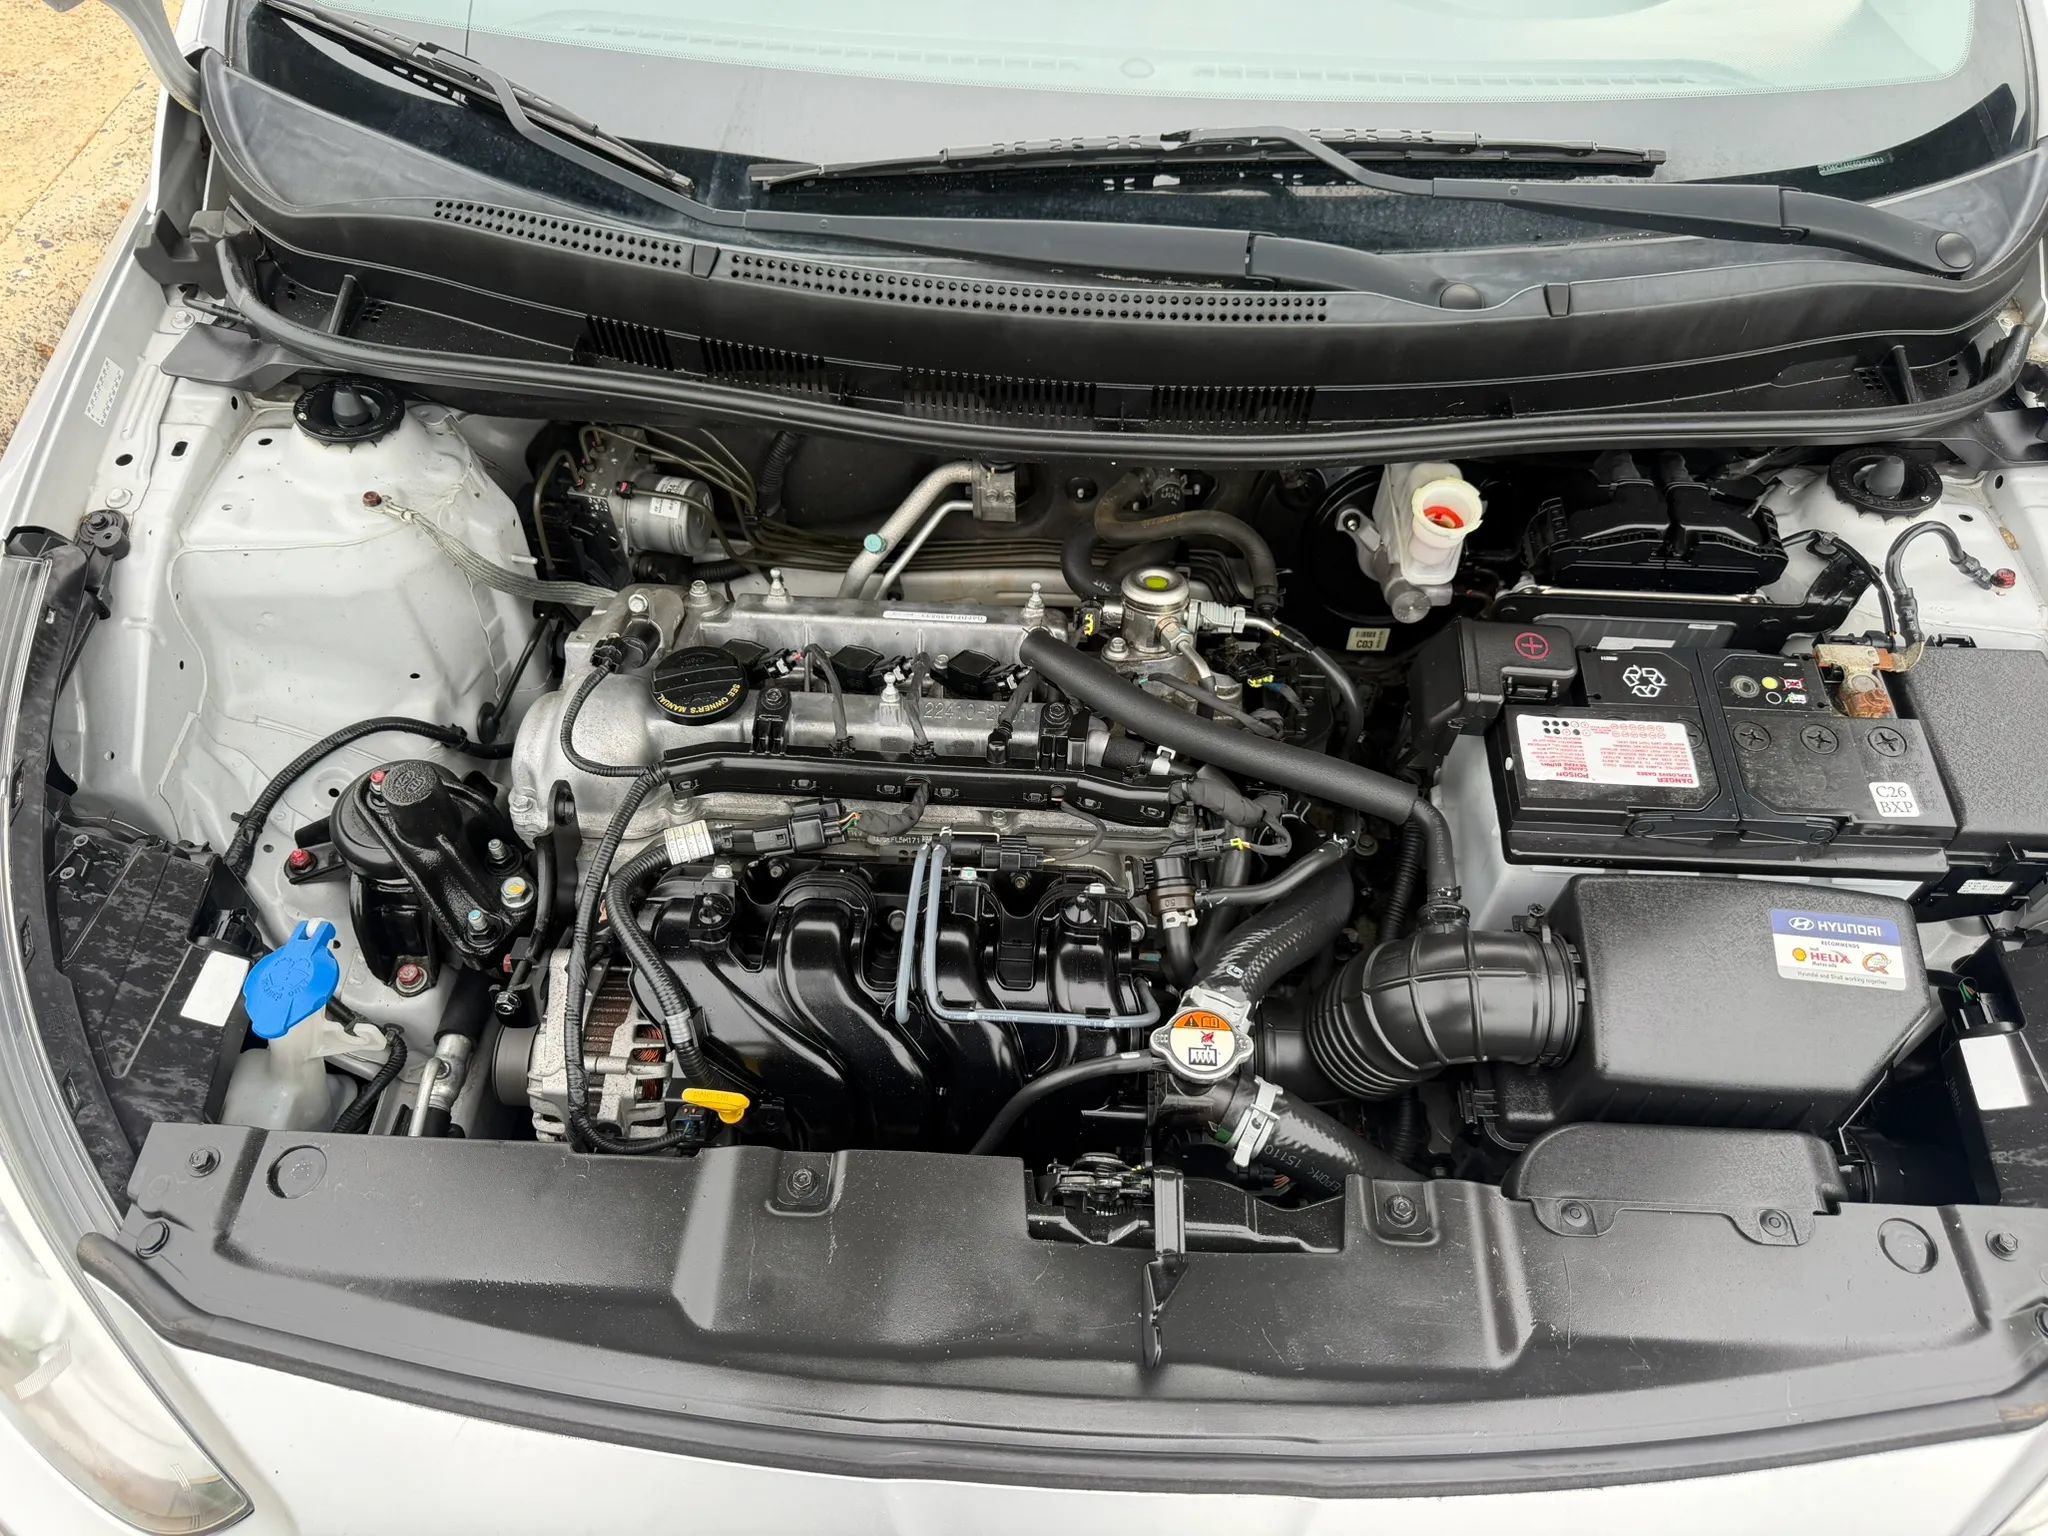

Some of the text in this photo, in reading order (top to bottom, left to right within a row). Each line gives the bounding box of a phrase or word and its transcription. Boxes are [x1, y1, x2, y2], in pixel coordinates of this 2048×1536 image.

[656, 683, 741, 714] SEE OWNER'S MANUAL
[1555, 771, 1589, 779] POISON
[1876, 786, 1907, 798] C26
[1880, 801, 1913, 813] BXP
[1817, 921, 1882, 937] HYUNDAI
[1821, 940, 1860, 949] RECOMMENDS
[1810, 951, 1852, 965] HELIX
[1264, 1144, 1302, 1169] 15110
